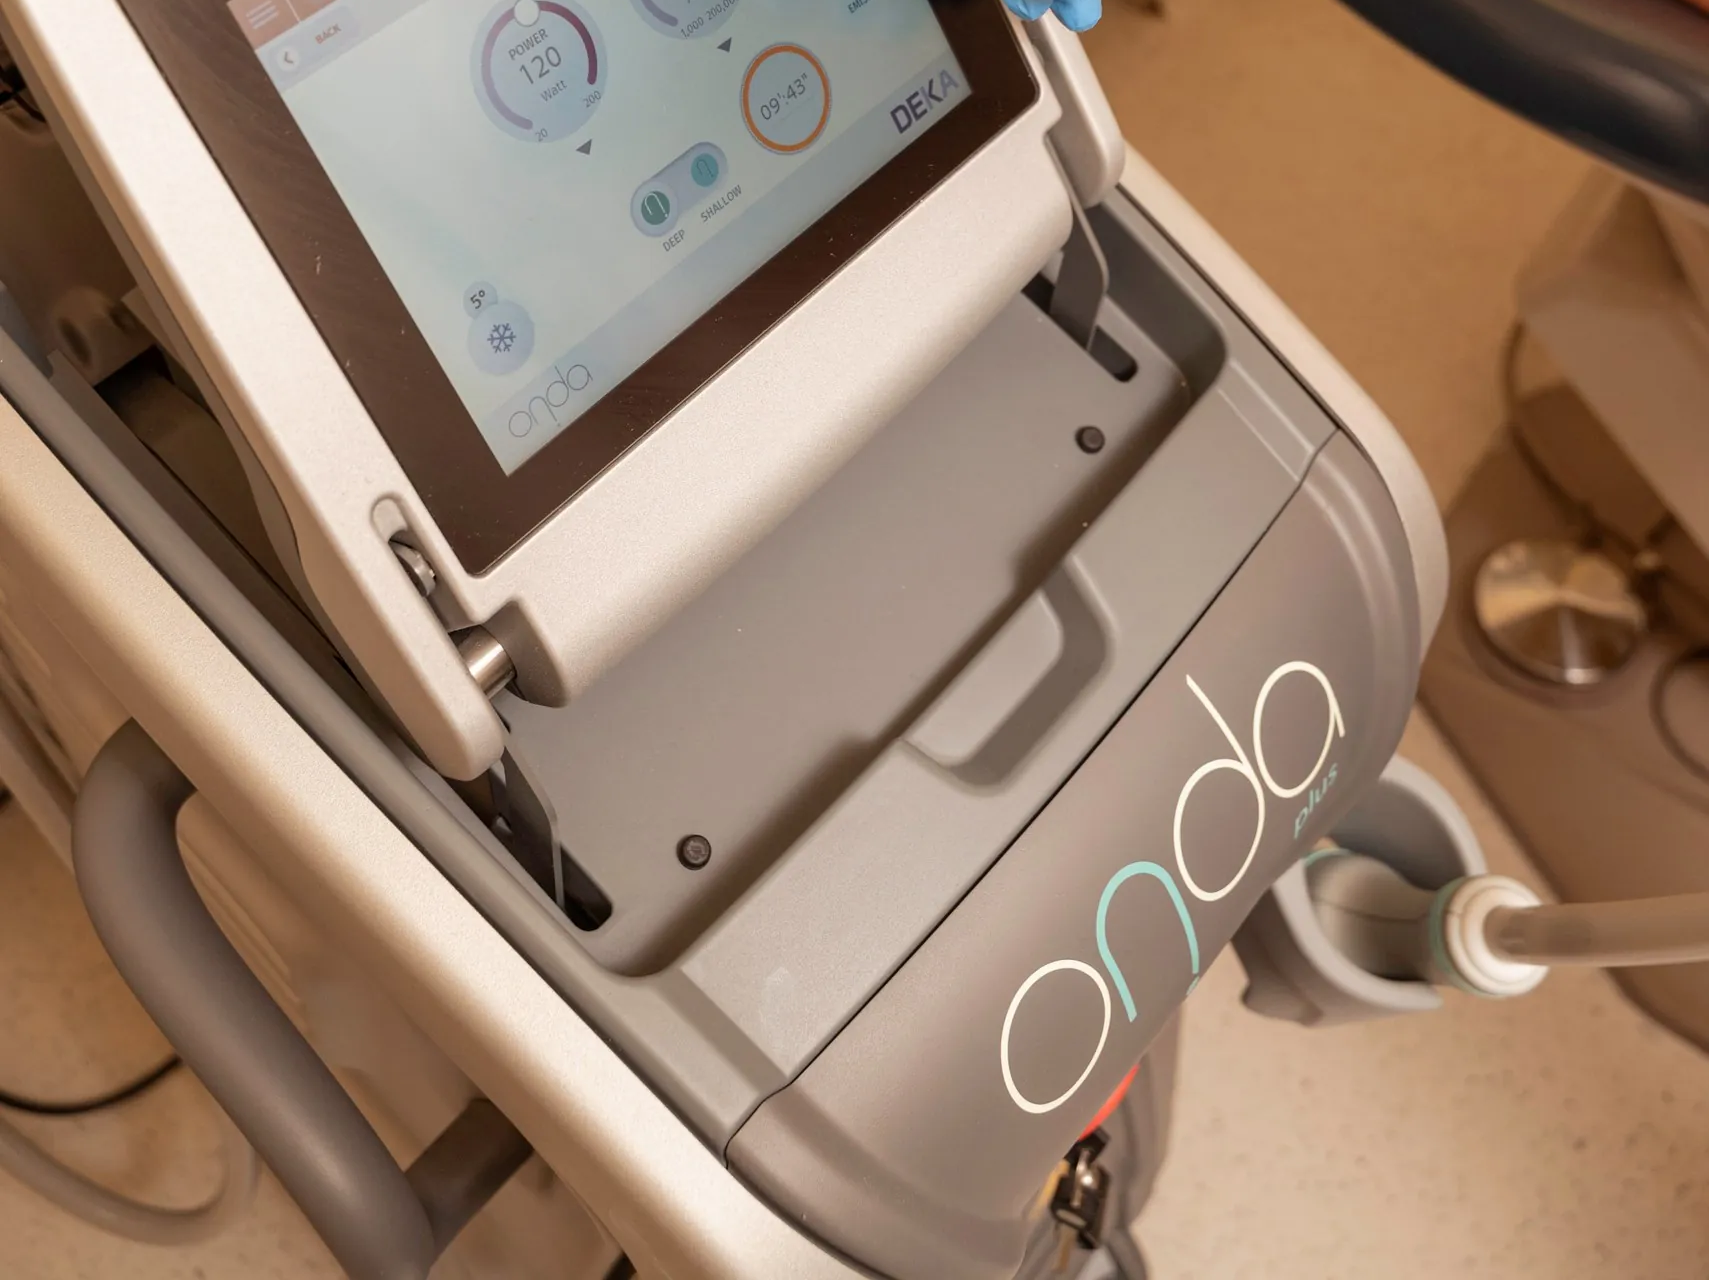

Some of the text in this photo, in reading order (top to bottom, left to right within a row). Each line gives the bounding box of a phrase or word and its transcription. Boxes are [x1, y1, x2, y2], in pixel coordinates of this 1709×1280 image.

[315, 23, 342, 44] BACK
[508, 28, 549, 60] POWER
[680, 17, 704, 39] 1,000
[519, 46, 562, 85] 120
[540, 80, 568, 102] Watt
[890, 70, 959, 134] DEKA
[535, 90, 601, 142] 20 200
[662, 184, 742, 252] DEEP SHALLOW
[470, 289, 486, 310] 5°
[508, 364, 593, 438] onda
[1294, 763, 1338, 839] plus
[1000, 661, 1346, 1114] onda
